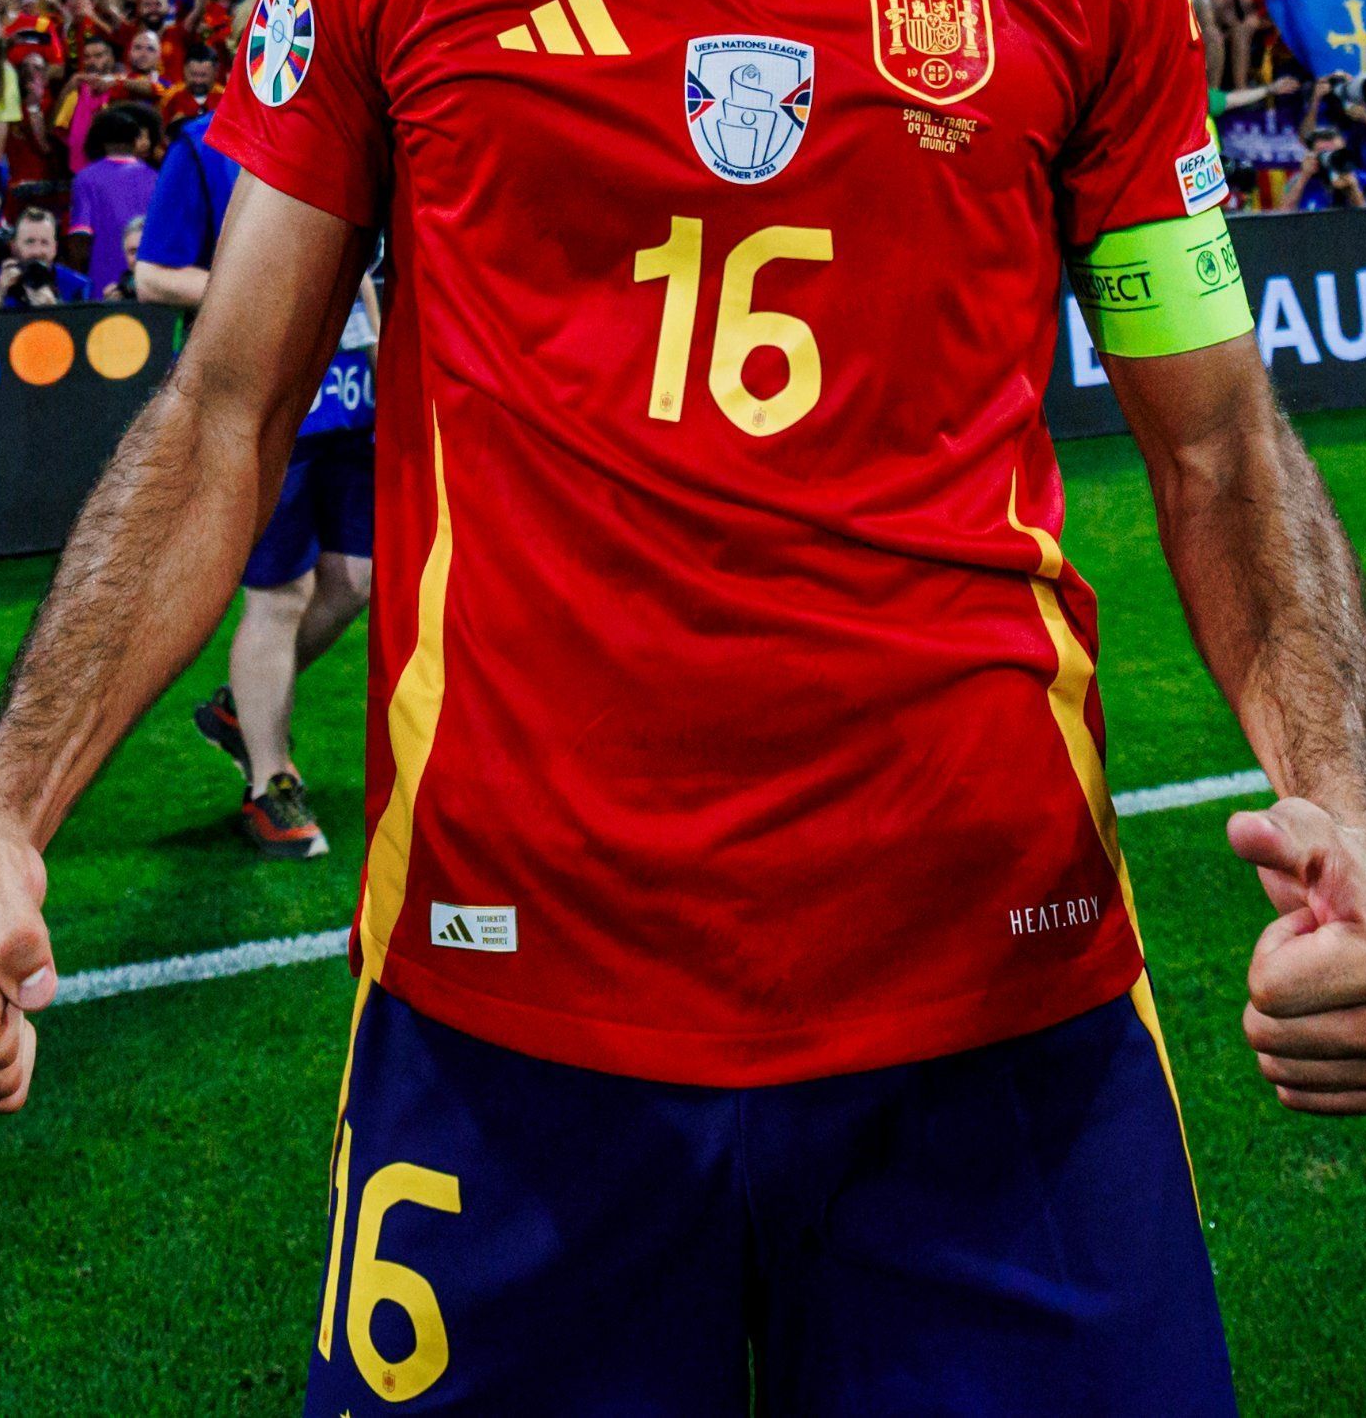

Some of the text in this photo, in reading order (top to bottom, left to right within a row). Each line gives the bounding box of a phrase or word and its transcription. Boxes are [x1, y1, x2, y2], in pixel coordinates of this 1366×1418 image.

[694, 41, 808, 58] UEFA NATIONS LEAGUE
[902, 108, 932, 124] SPAIN
[943, 116, 978, 132] FRANCE
[907, 122, 971, 144] 09 JULY 2024
[919, 138, 956, 154] MUNICH
[713, 159, 776, 179] WINNER 2023
[1180, 154, 1206, 174] UEFA
[1221, 242, 1241, 274] RE
[633, 214, 833, 438] 16
[1009, 895, 1100, 935] HEAT.RDY
[318, 1117, 462, 1403] 16
